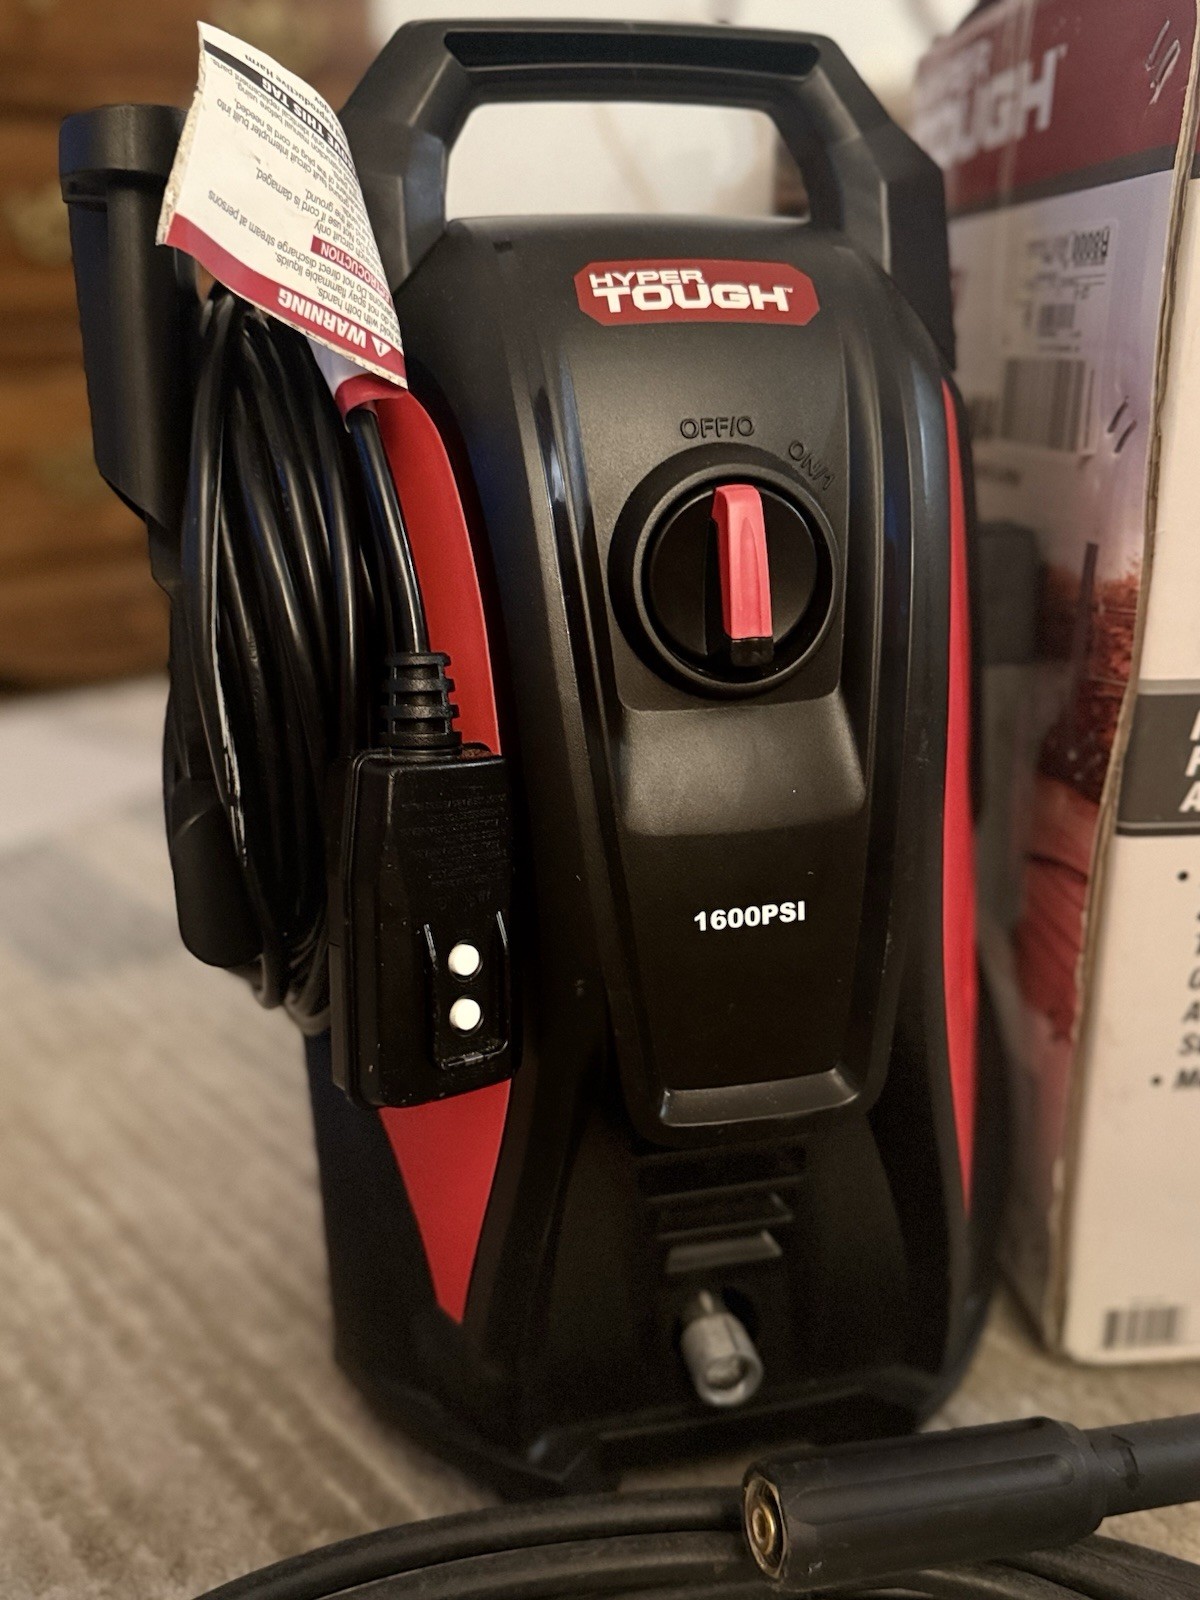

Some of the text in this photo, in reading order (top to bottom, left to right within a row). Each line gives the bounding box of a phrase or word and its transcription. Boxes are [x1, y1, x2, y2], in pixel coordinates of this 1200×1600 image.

[244, 54, 273, 79] Harm
[260, 77, 289, 108] TAG
[217, 98, 232, 118] into
[233, 109, 249, 131] built
[265, 123, 273, 134] is
[293, 102, 325, 138] THIS
[251, 123, 289, 159] interrupter
[273, 129, 290, 147] cord
[290, 152, 310, 174] circuit
[255, 167, 293, 201] damaged.
[207, 190, 239, 221] persons
[293, 195, 301, 209] is
[301, 201, 319, 218] cord
[305, 188, 333, 212] ground.
[239, 214, 248, 227] at
[313, 219, 331, 235] only
[327, 216, 341, 230] use
[249, 221, 276, 246] stream
[332, 231, 353, 251] circuit
[275, 251, 303, 277] liquids.
[276, 241, 317, 268] discharge
[319, 263, 340, 281] direct
[342, 275, 356, 289] not
[589, 269, 704, 288] HYPER
[305, 268, 347, 299] flammable
[317, 286, 343, 310] hands.
[347, 289, 366, 308] spay
[593, 283, 793, 313] TOUGH
[276, 287, 366, 348] WARNING
[346, 301, 363, 321] both
[364, 313, 378, 329] with
[368, 303, 380, 318] not
[693, 900, 805, 932] 1600PSI
